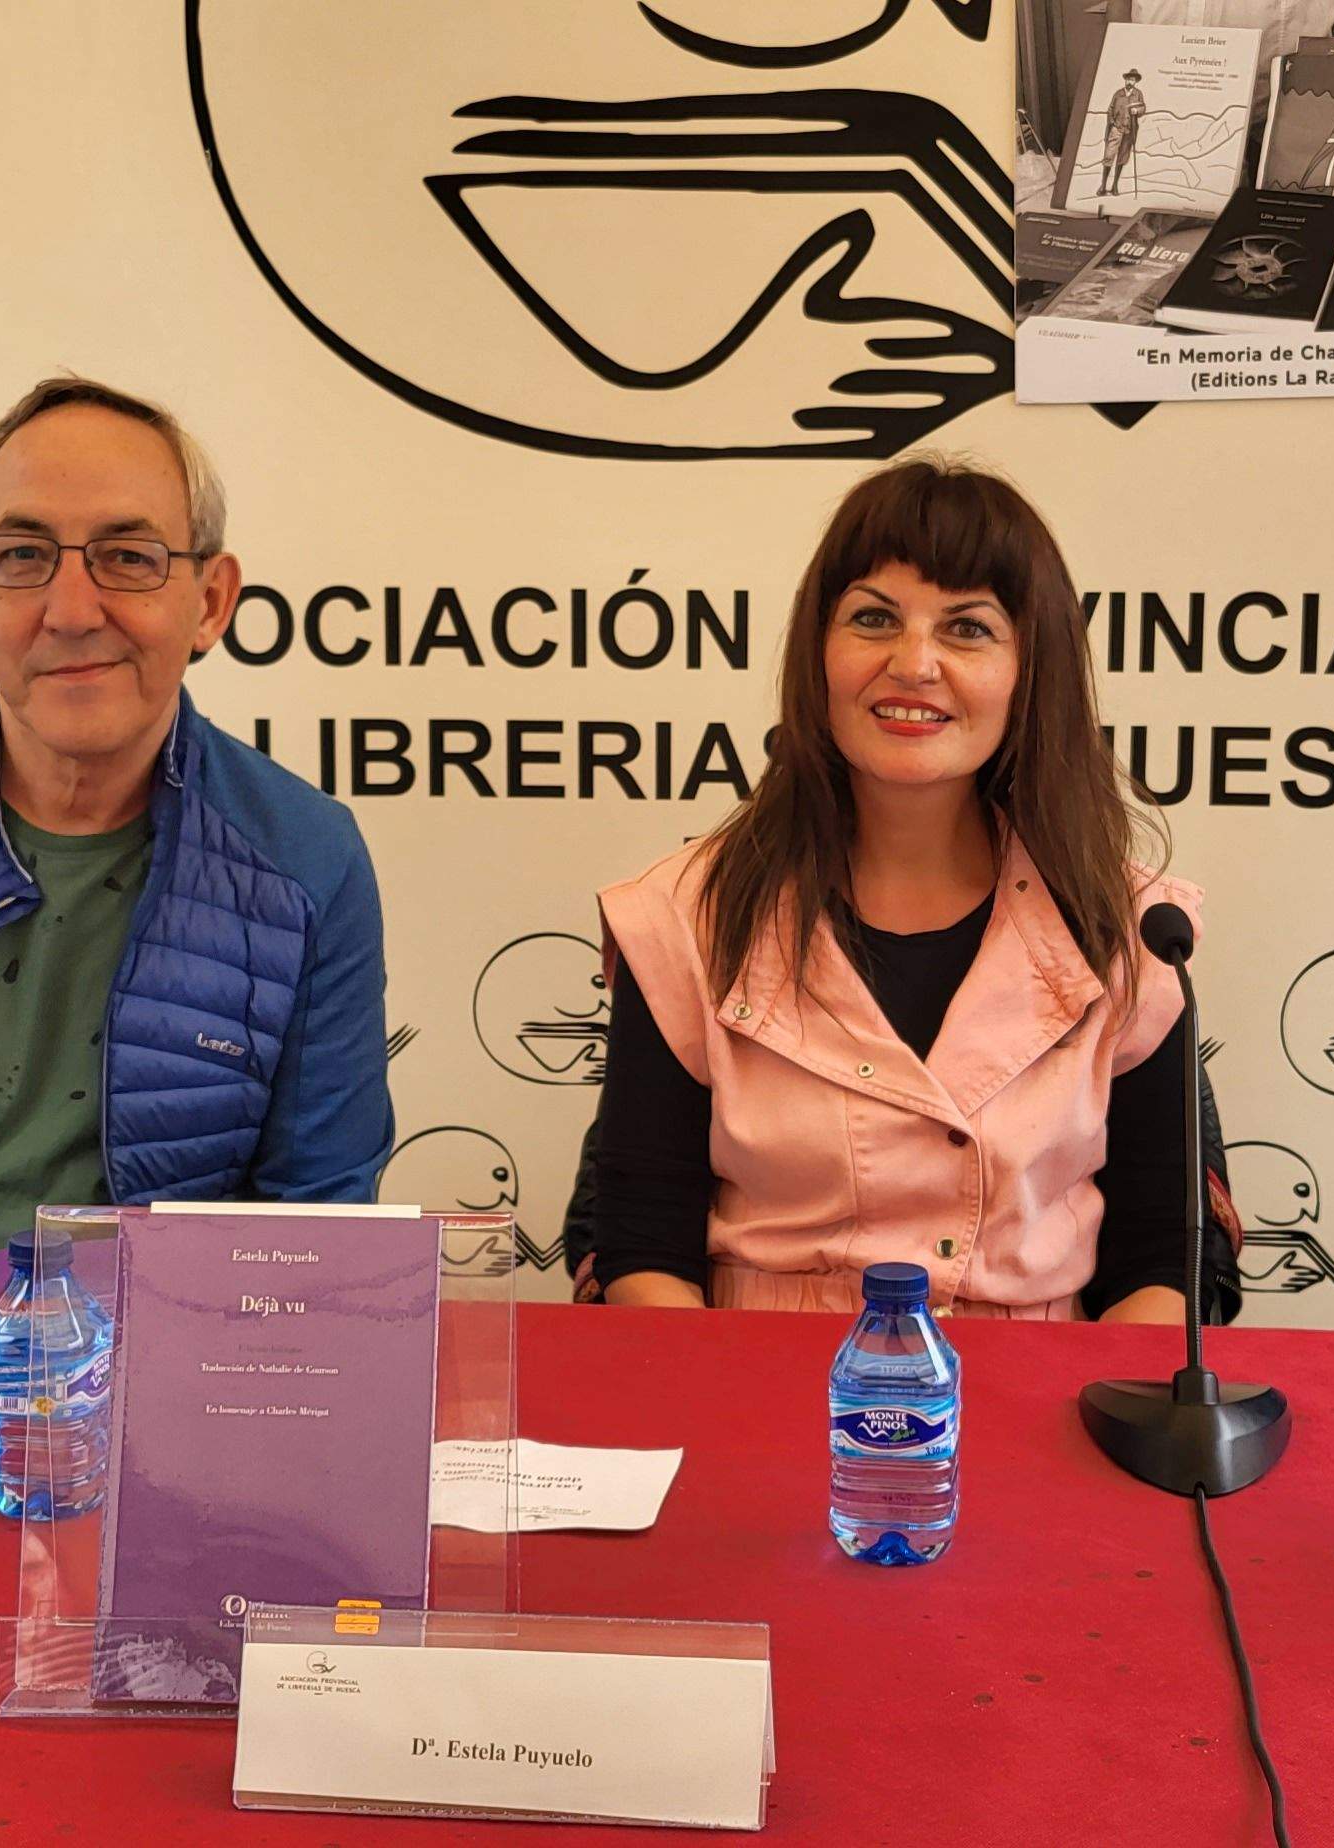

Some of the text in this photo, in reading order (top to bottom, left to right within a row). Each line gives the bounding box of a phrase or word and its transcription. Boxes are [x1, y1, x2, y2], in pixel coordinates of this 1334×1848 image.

[1148, 246, 1191, 262] Vero
[1179, 346, 1263, 364] Memoria
[1269, 345, 1294, 362] de
[1190, 371, 1278, 392] (Editions
[1285, 369, 1308, 386] La
[189, 568, 749, 670] OCIACIÓN
[231, 1248, 320, 1266] Estela Puyuelo
[240, 1294, 306, 1318] Déjà vu
[246, 1363, 257, 1374] de
[293, 1365, 305, 1375] de
[219, 1404, 258, 1417] homenaje
[266, 1405, 297, 1417] Charles
[864, 1411, 908, 1422] MONTE
[870, 1420, 909, 1430] PINOS
[320, 1677, 359, 1686] PROVINCIAL
[336, 1686, 361, 1694] HUESCA
[446, 1740, 507, 1762] Estela
[513, 1744, 593, 1769] Puyuelo
